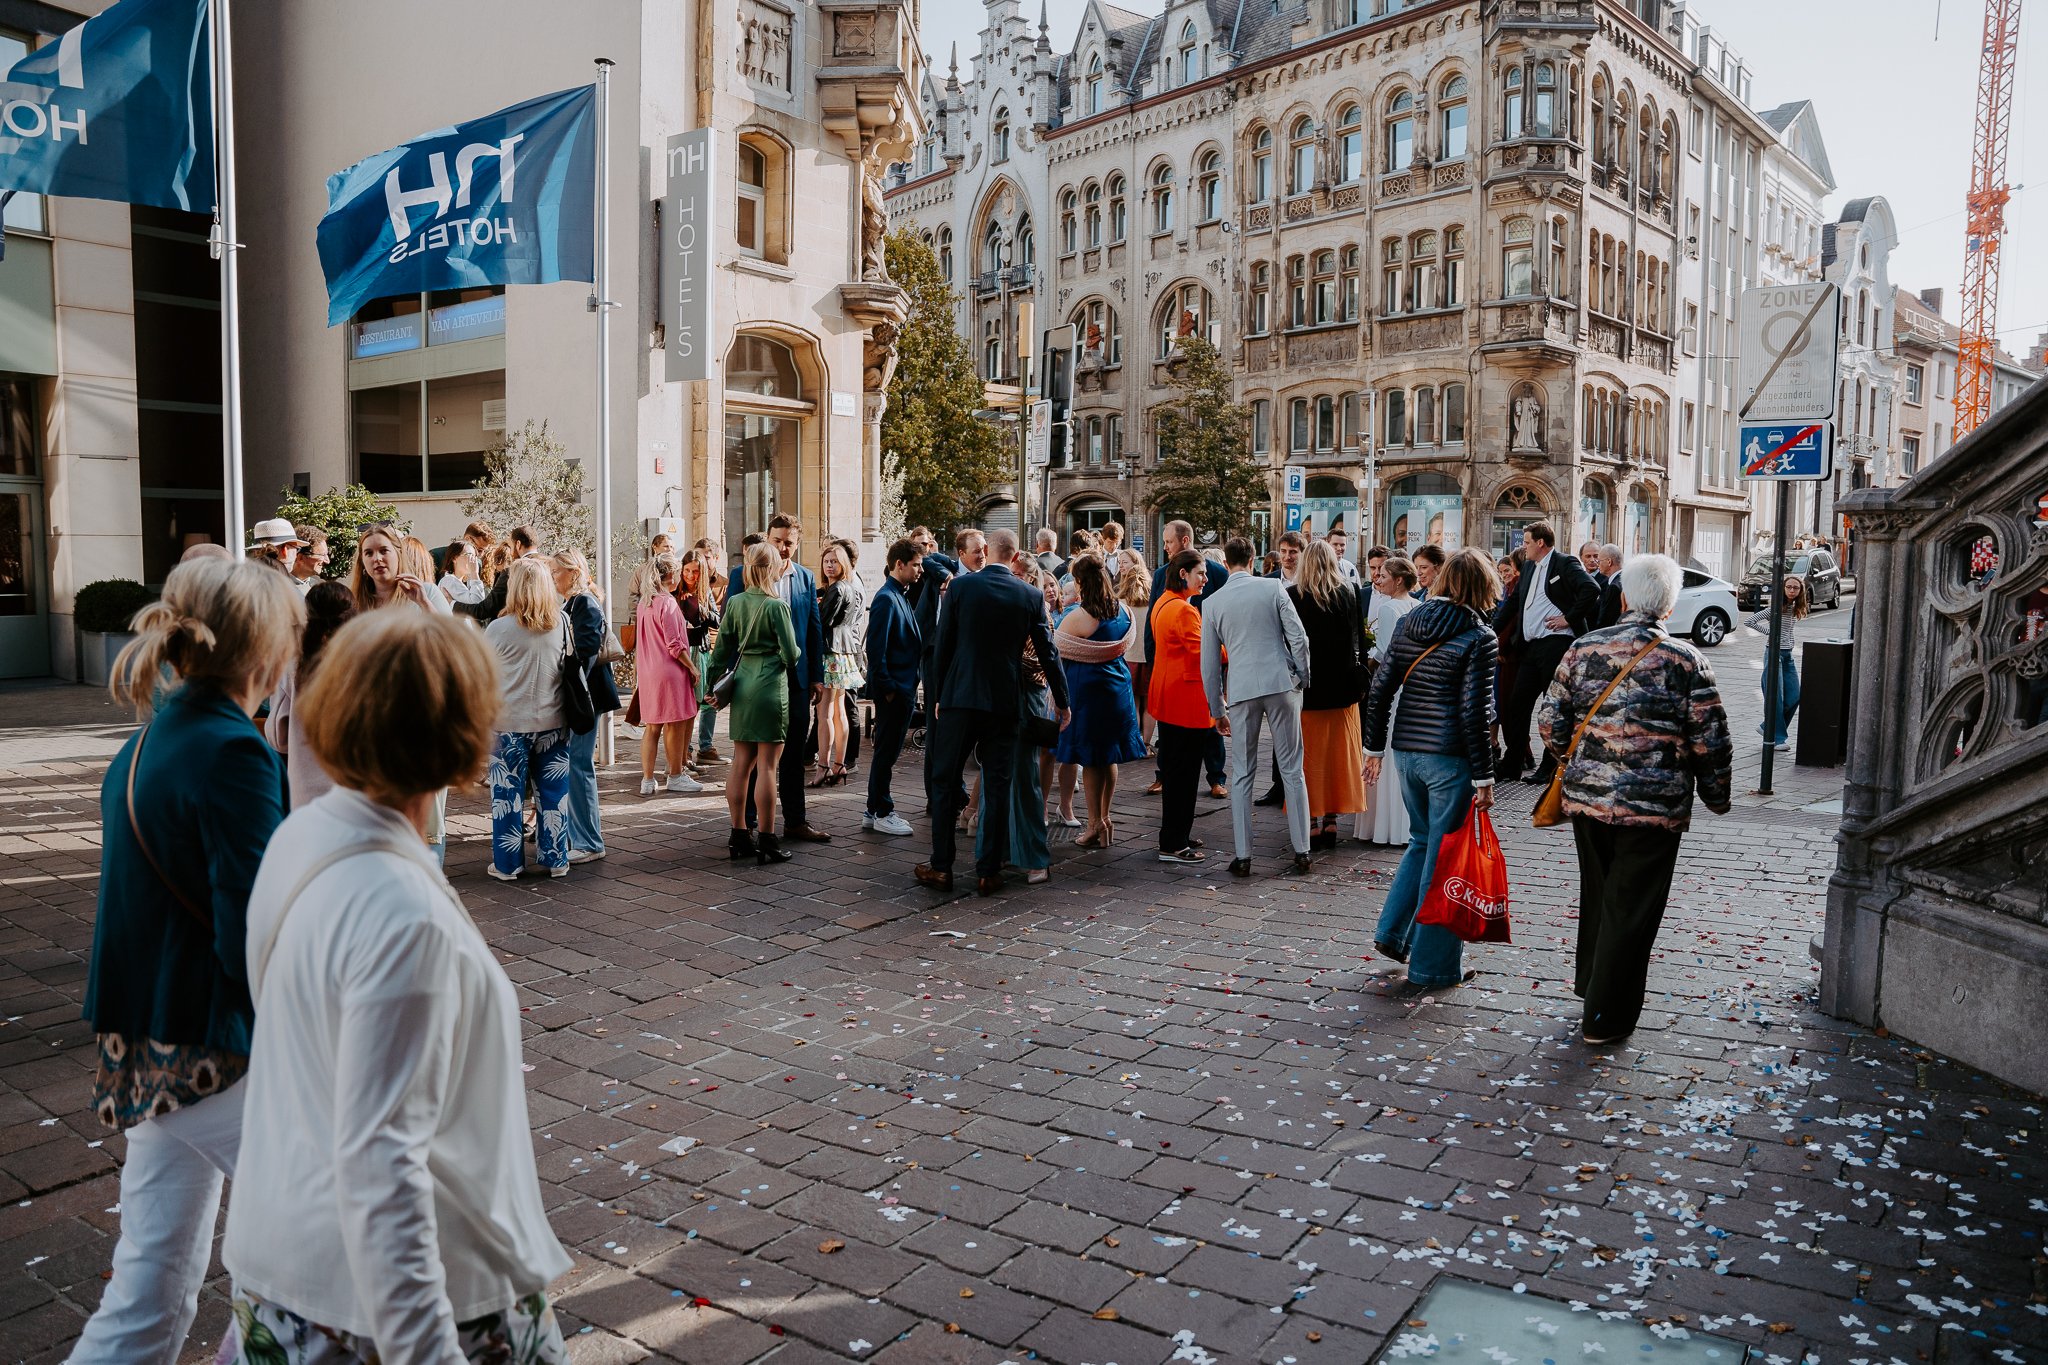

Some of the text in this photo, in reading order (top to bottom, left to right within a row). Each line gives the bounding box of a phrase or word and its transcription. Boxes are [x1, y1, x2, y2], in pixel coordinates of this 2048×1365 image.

[677, 196, 695, 357] HOTELS
[1760, 289, 1816, 309] ZONE
[359, 326, 413, 346] RESTAURANT
[431, 318, 451, 333] VAN
[1289, 508, 1300, 526] P
